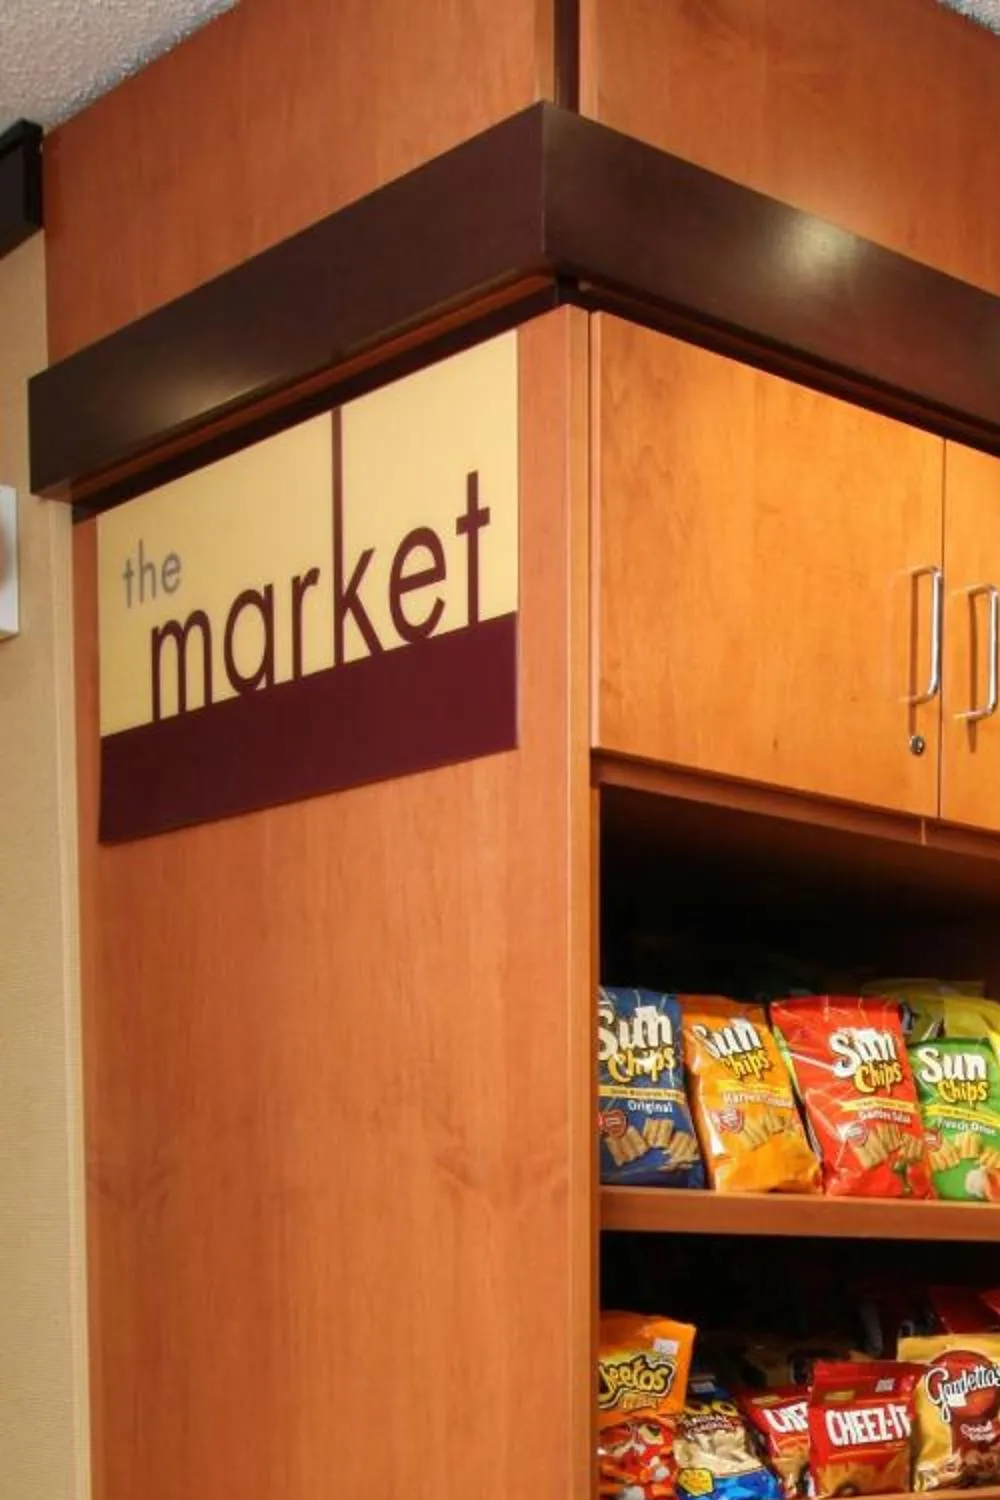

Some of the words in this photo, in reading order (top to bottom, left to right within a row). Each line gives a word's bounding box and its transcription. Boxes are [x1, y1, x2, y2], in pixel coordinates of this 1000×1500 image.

[122, 539, 181, 608] the
[150, 403, 491, 721] market
[598, 1005, 672, 1061] Sun
[692, 1017, 763, 1059] Sun
[829, 1028, 897, 1079] Sun
[607, 1046, 676, 1083] Chips
[854, 1060, 903, 1095] Chips
[918, 1047, 987, 1083] Sun
[938, 1079, 990, 1109] Chips
[825, 1403, 912, 1447] CHEEZ-IT
